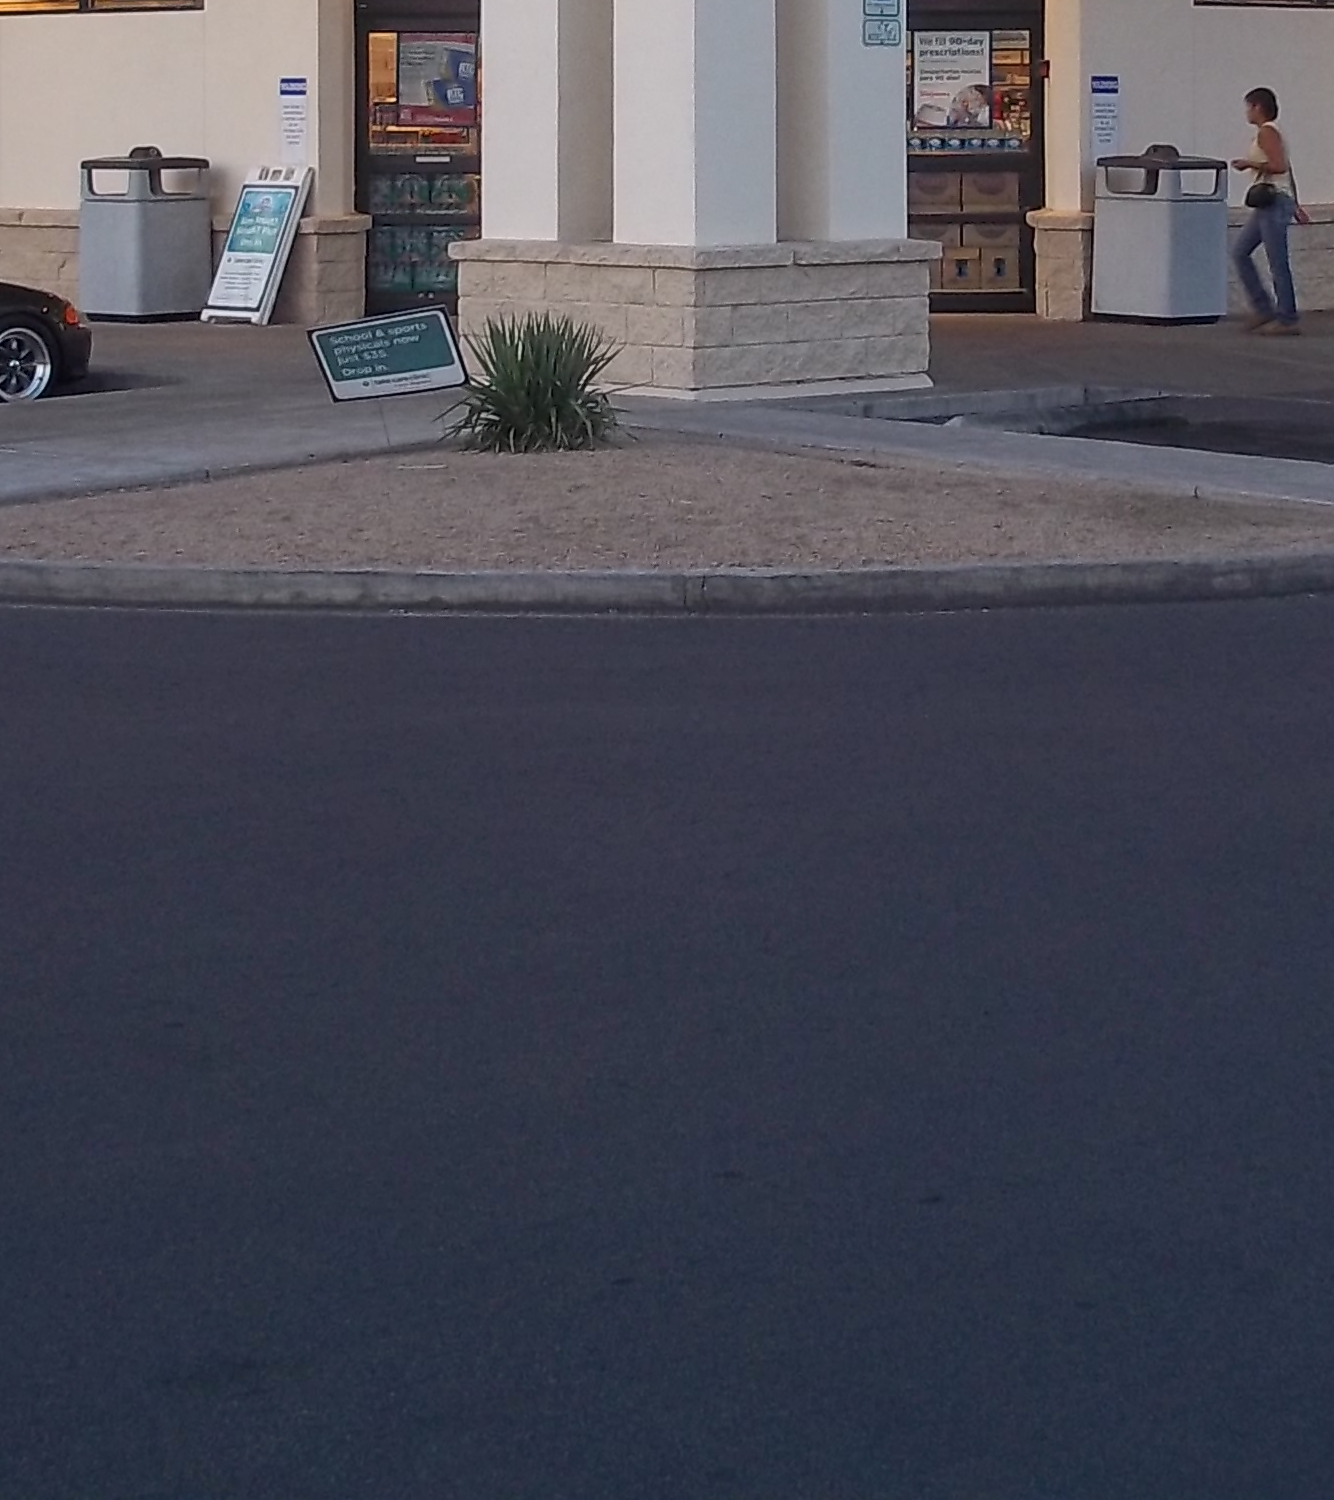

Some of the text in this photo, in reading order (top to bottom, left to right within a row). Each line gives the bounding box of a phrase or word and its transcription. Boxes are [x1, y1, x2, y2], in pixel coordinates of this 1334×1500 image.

[948, 36, 984, 46] 90-day
[329, 322, 428, 345] School & sports
[334, 334, 420, 356] physicals now
[341, 363, 373, 377] Drop
